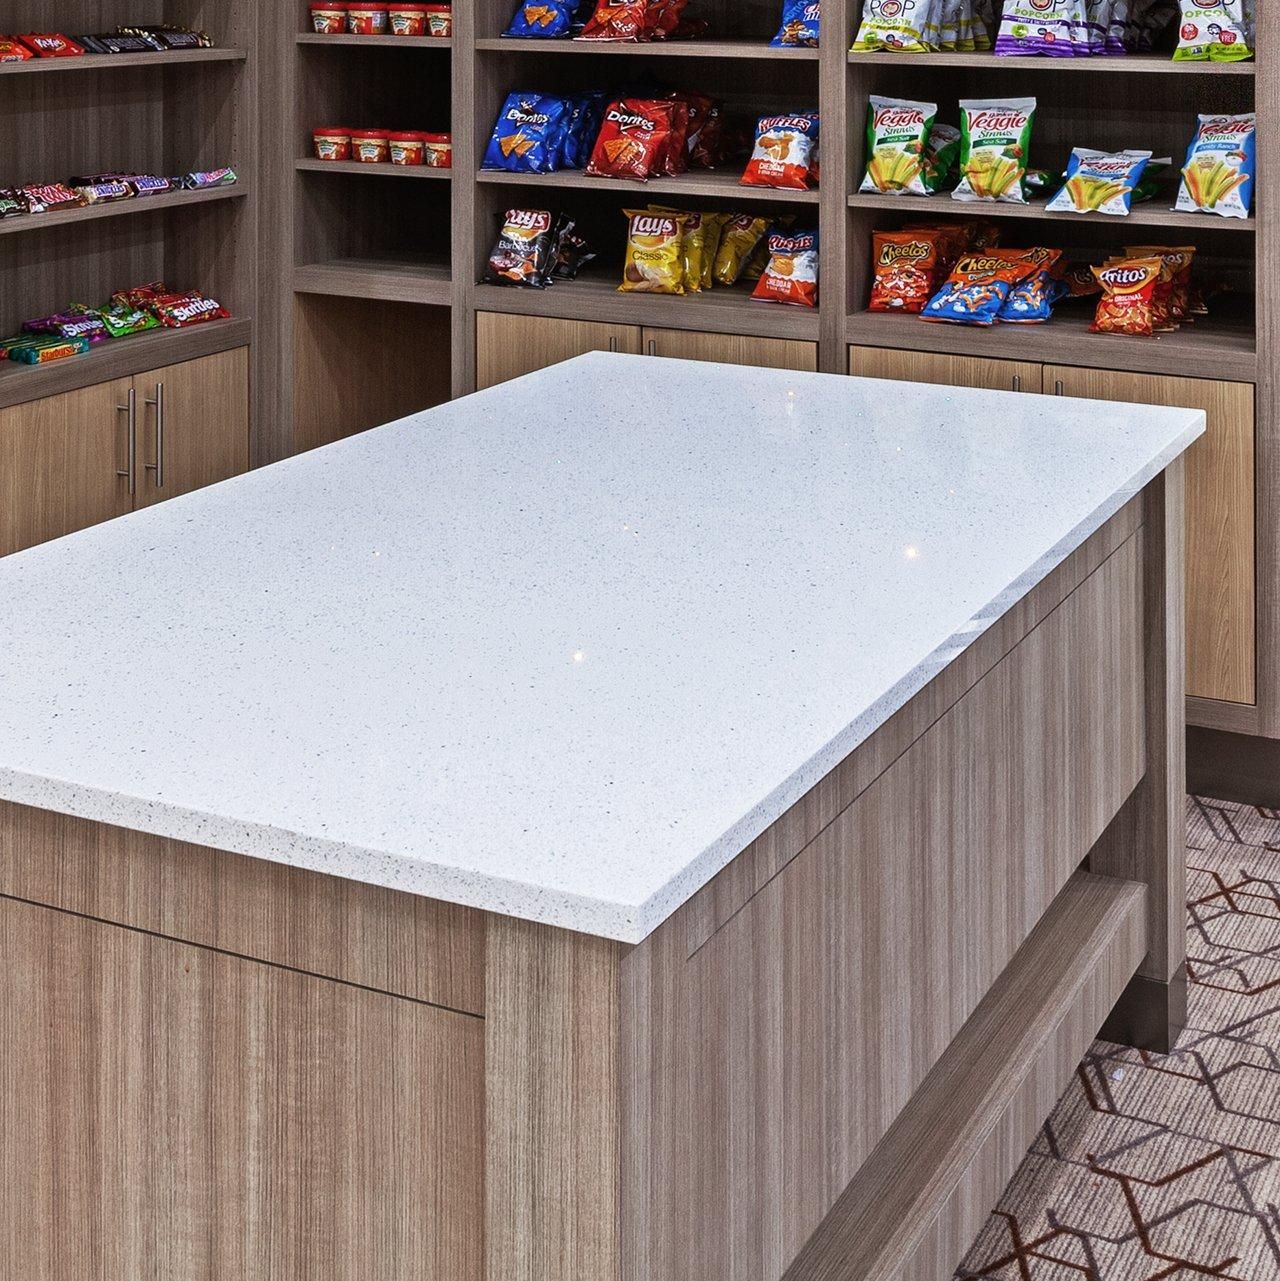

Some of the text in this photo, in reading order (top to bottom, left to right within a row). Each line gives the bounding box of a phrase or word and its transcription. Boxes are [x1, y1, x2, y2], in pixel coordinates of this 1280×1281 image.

[869, 0, 916, 18] POP
[1014, 6, 1064, 20] POPCORN
[506, 108, 549, 125] Doritos
[606, 109, 655, 132] Doritos
[758, 118, 812, 132] RUFFLES
[873, 111, 925, 130] Veggie
[967, 111, 1028, 131] Veggie
[1198, 120, 1255, 138] Veggie
[631, 250, 669, 261] Classic
[878, 241, 931, 265] Cheetos
[1099, 267, 1147, 287] Fritos
[1112, 293, 1144, 303] ORIGINAL
[173, 297, 220, 322] Skittles
